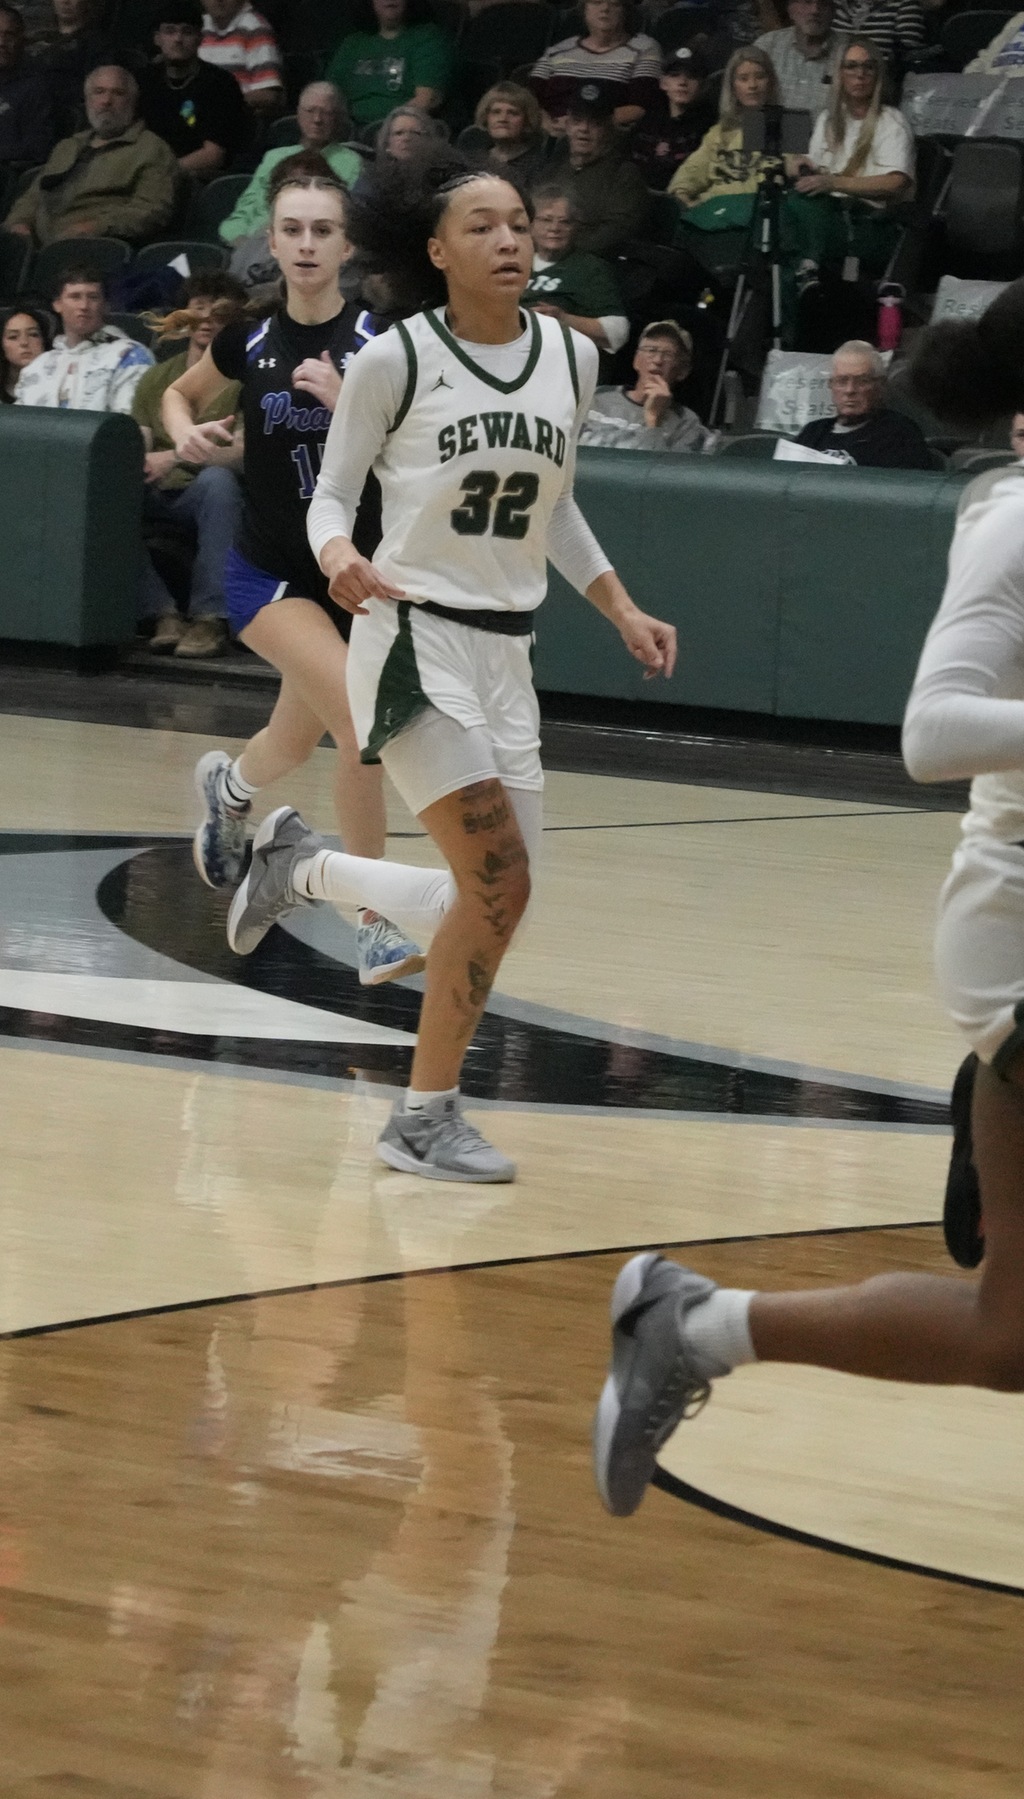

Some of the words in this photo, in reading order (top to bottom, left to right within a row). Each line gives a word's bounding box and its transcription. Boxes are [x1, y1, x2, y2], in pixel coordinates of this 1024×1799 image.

[437, 410, 567, 469] SEWARD
[290, 443, 326, 499] 1
[450, 469, 540, 541] 32
